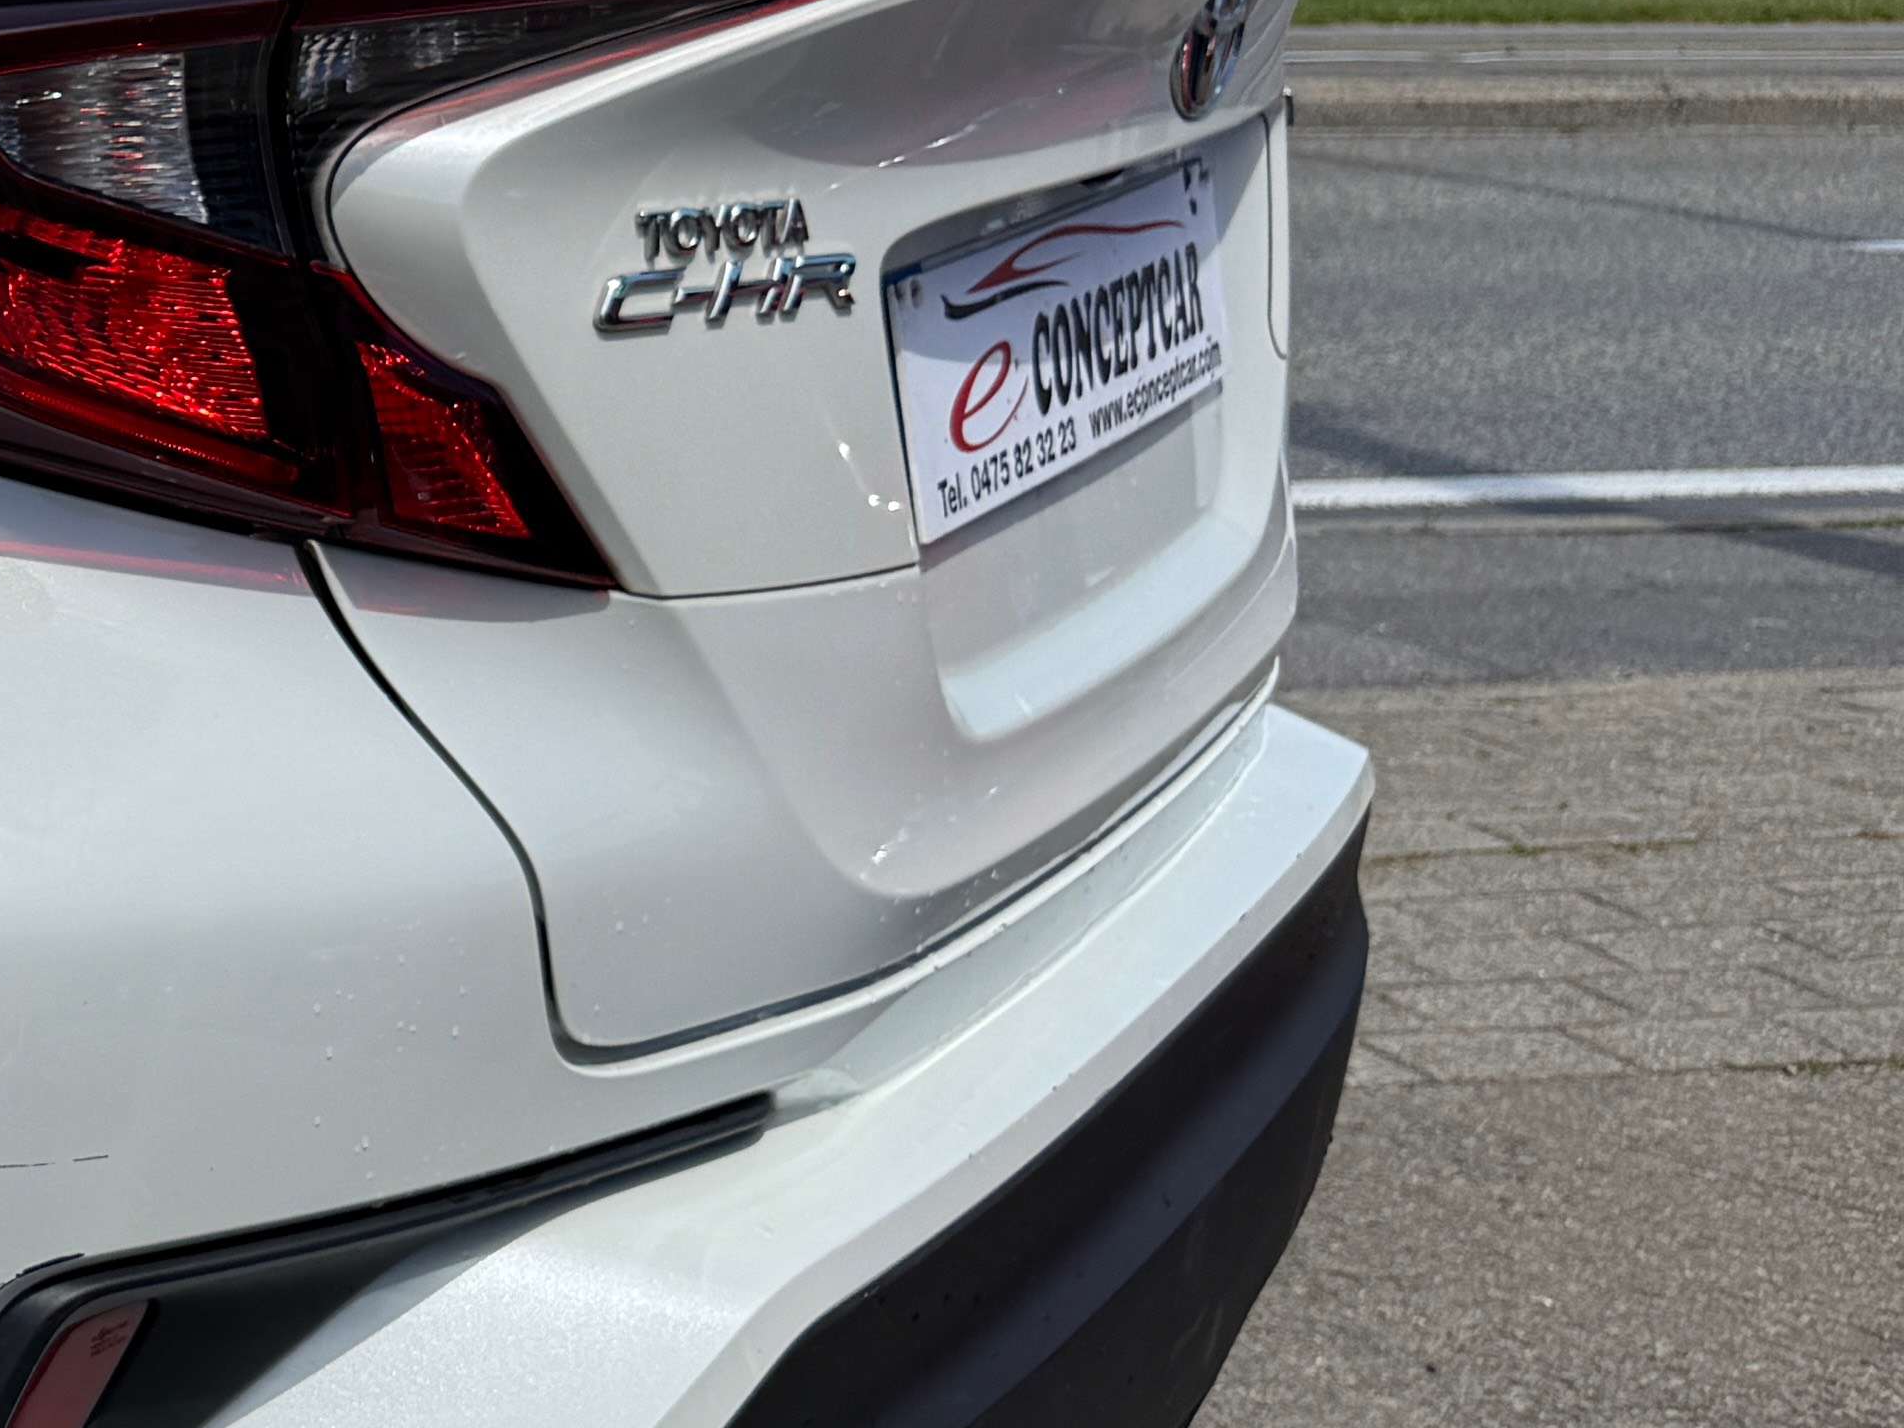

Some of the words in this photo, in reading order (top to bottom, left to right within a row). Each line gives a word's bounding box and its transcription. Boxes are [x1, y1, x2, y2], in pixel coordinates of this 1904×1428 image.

[593, 252, 857, 332] C-HR
[635, 198, 809, 264] TOYOTA
[1032, 241, 1204, 415] CONCEPTCAR
[937, 477, 968, 518] Tel.
[970, 449, 1009, 502] 0475
[1014, 436, 1034, 481] 82
[1037, 429, 1056, 468] 32
[1059, 416, 1077, 456] 23
[1088, 341, 1223, 439] www.econceptcar.com
